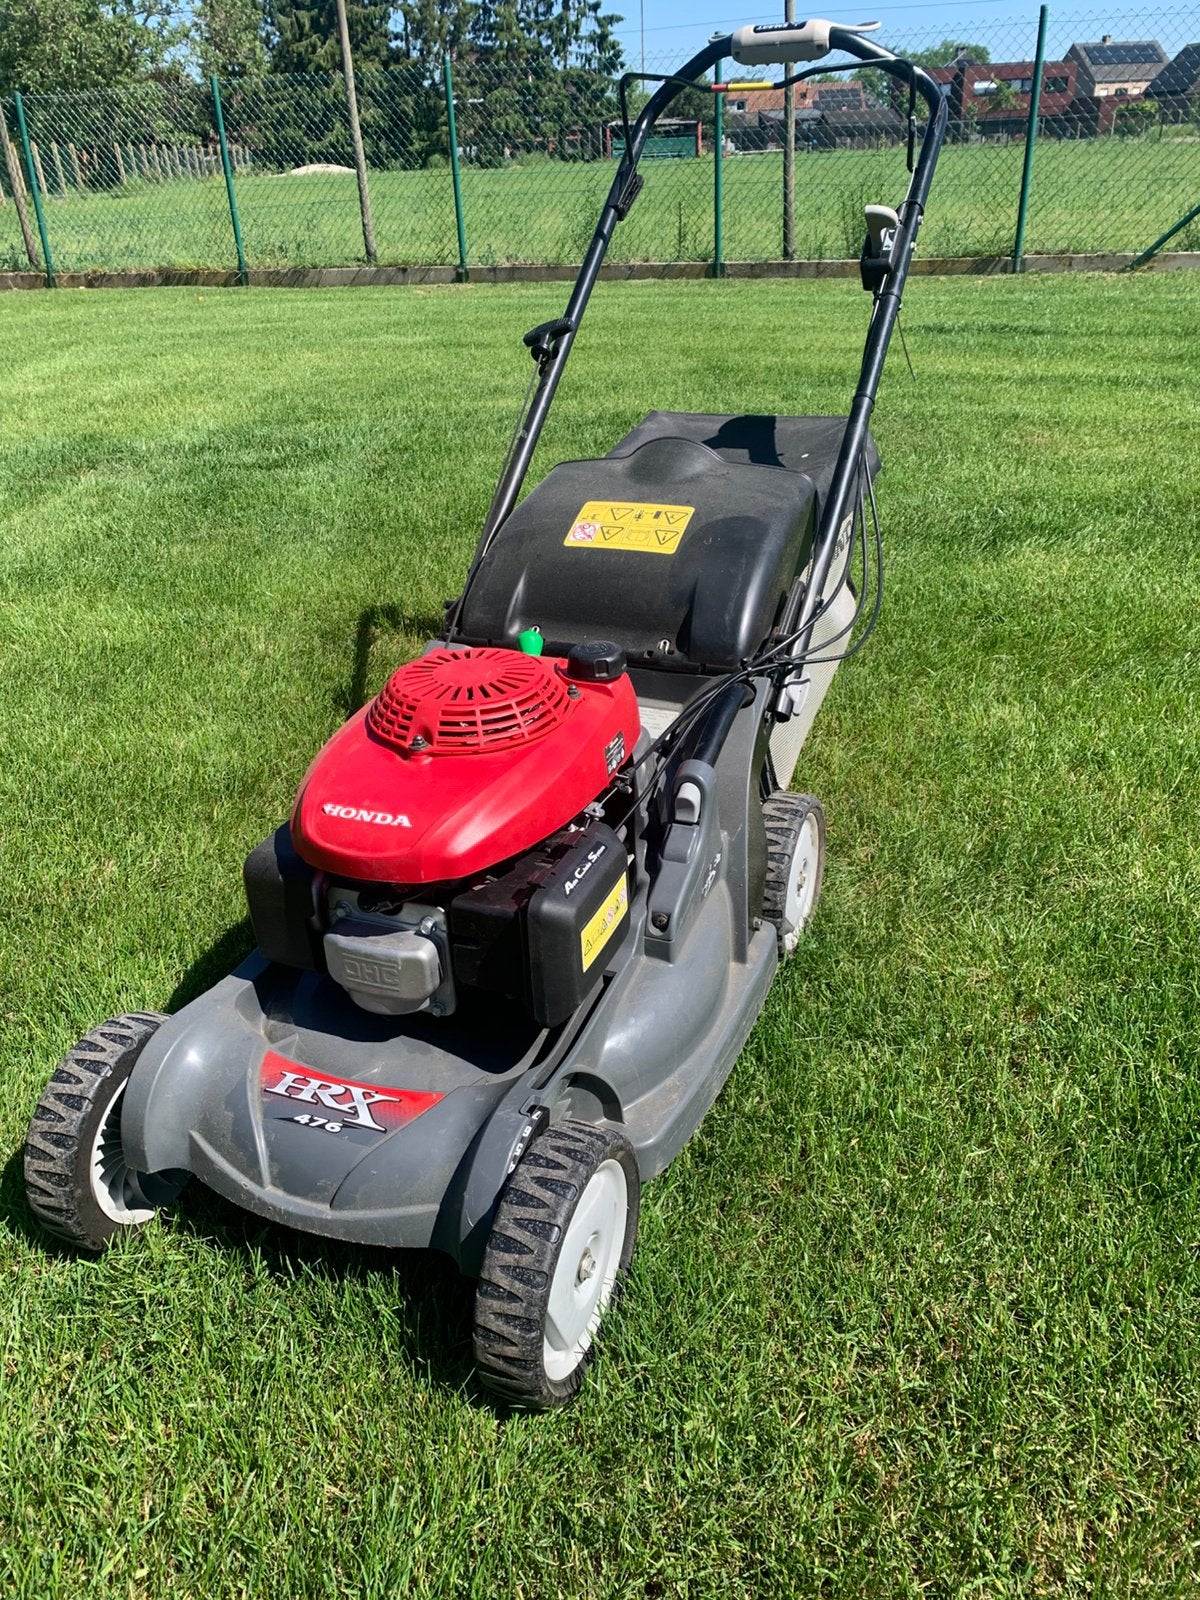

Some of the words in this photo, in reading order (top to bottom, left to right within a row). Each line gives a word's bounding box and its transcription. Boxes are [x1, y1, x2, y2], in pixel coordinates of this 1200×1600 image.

[322, 803, 412, 828] HONDA
[343, 959, 401, 985] OHC
[264, 1070, 402, 1134] HRX
[293, 1113, 344, 1134] 476
